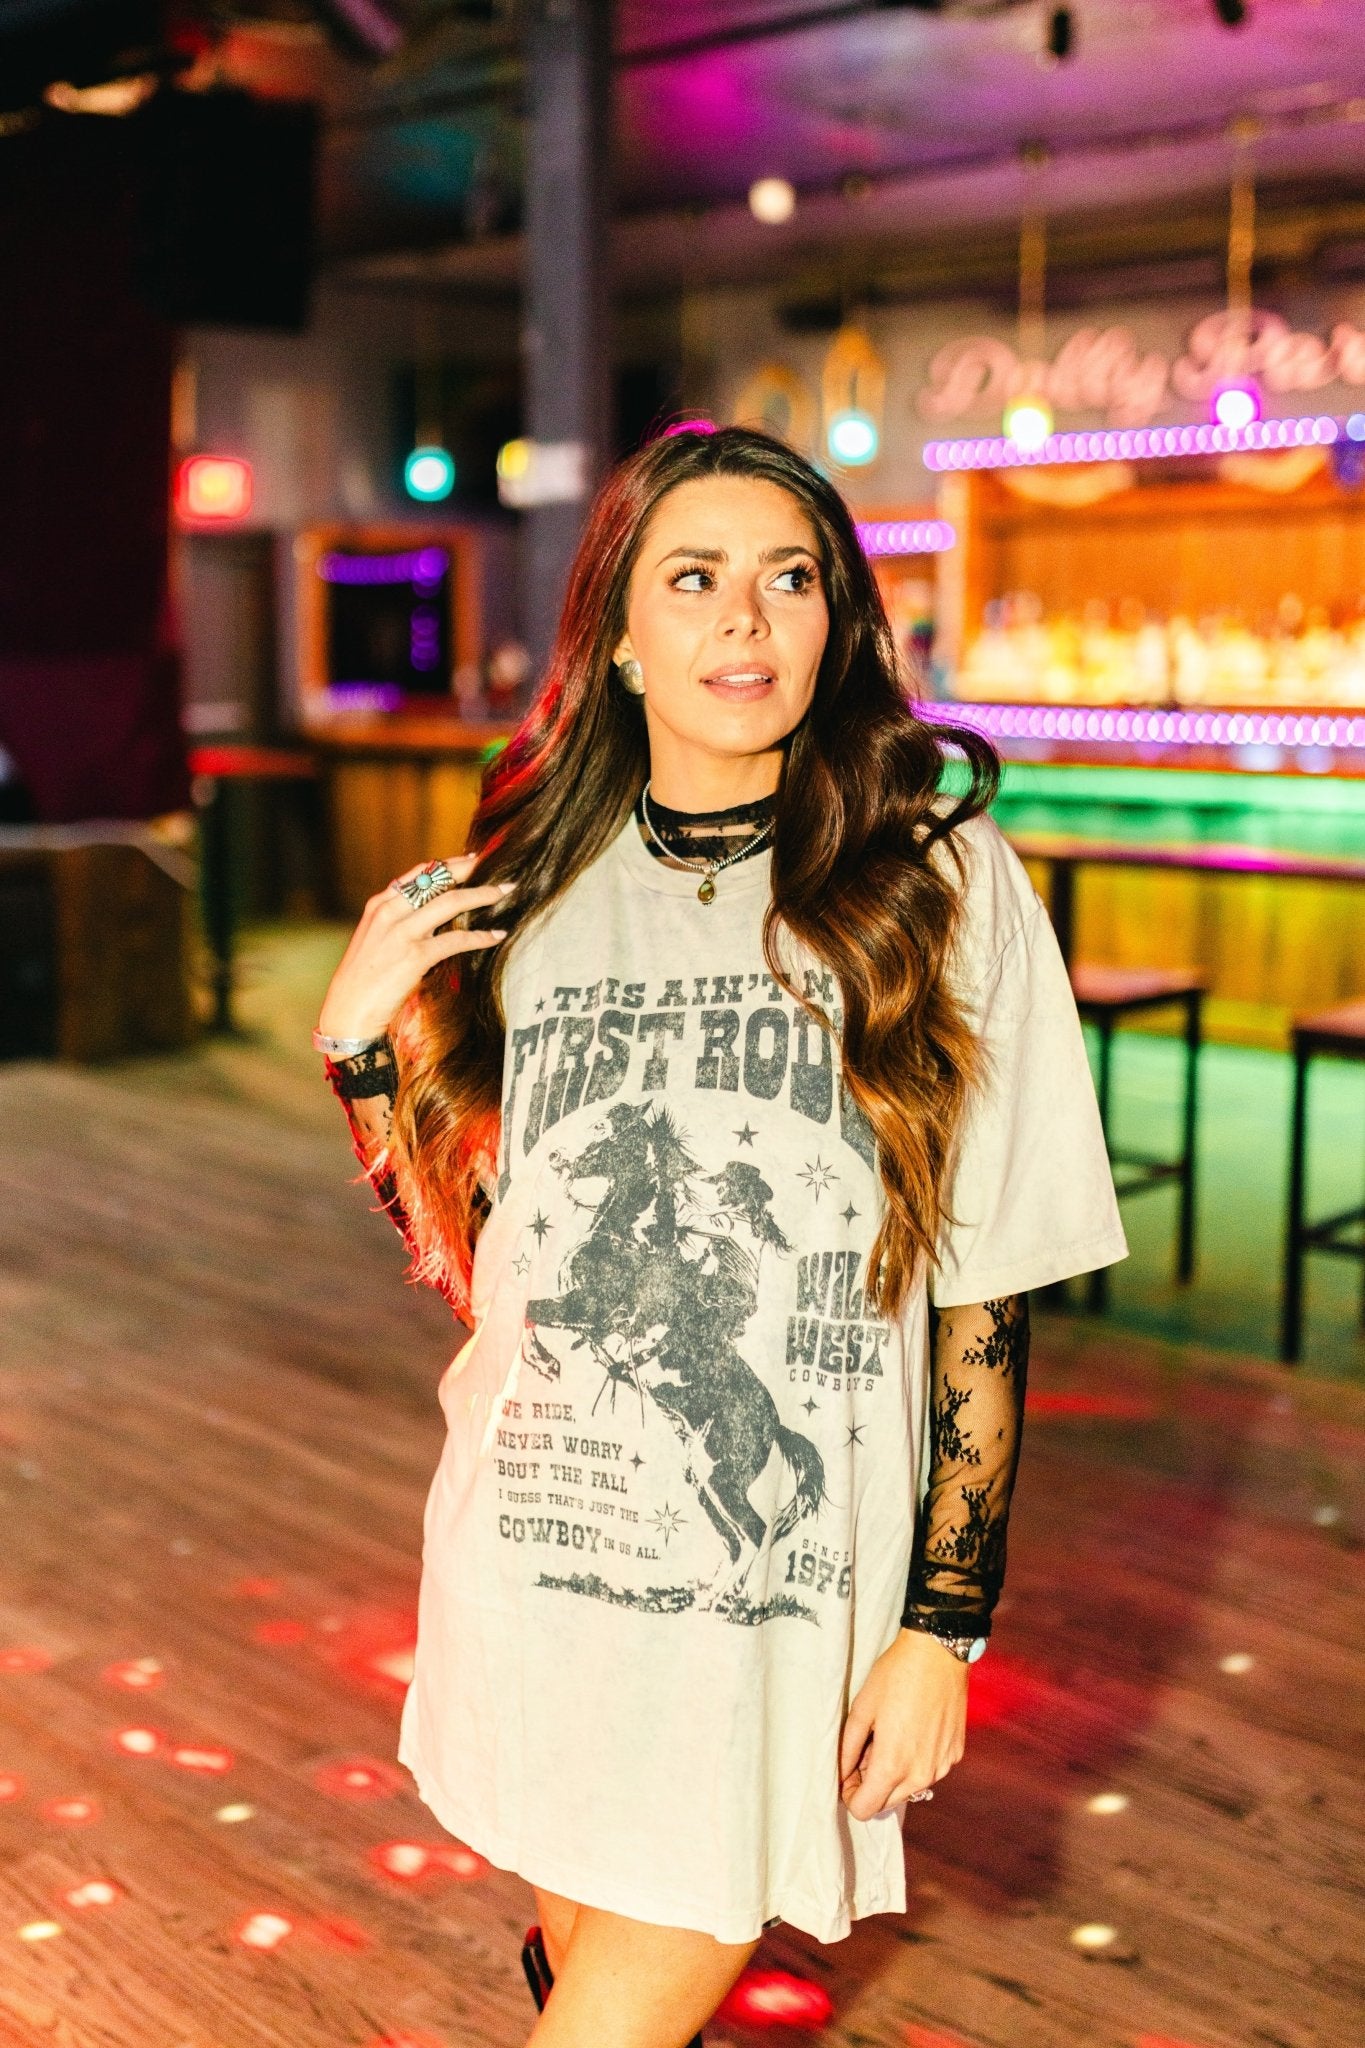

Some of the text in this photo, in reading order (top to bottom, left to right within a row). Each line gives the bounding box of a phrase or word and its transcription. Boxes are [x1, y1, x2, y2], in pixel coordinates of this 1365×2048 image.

[553, 977, 646, 1012] THIS
[656, 973, 791, 1007] AIN'T
[497, 1004, 876, 1206] FIRST ROD
[785, 1315, 891, 1377] WEST
[789, 1368, 874, 1392] COWBOYS
[532, 1402, 576, 1424] RIDE,
[497, 1429, 623, 1461] NEVER WORRY
[494, 1458, 628, 1494] 'BOUT THE FALL
[498, 1488, 639, 1523] I GUESS THAT'S JUST THE
[499, 1514, 661, 1560] COWBOY IN US ALL.
[802, 1538, 849, 1562] SINCE
[785, 1550, 852, 1600] 1976
